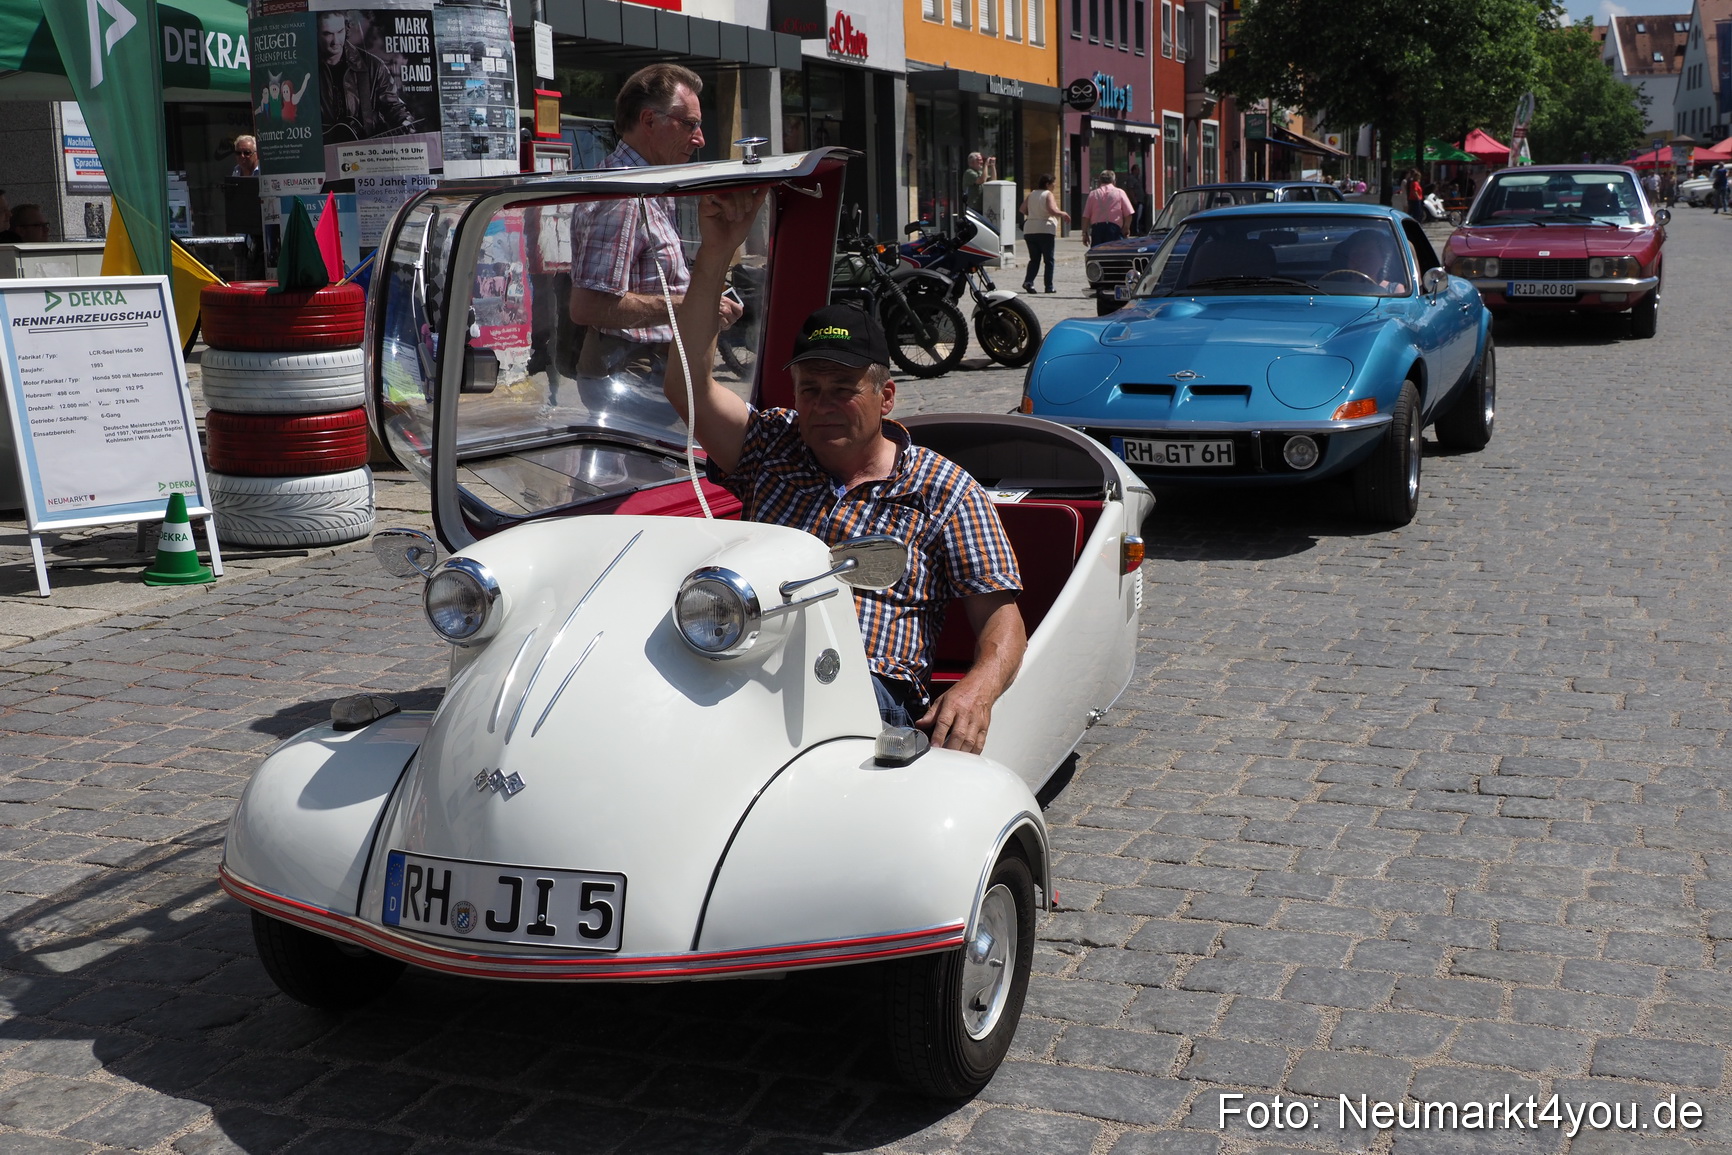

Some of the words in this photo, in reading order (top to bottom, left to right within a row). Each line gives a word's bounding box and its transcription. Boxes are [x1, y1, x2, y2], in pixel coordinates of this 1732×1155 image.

[394, 17, 429, 35] MARK
[164, 25, 251, 70] DEKRA
[385, 36, 430, 54] BENDER
[401, 64, 432, 82] BAND
[416, 84, 433, 92] concert
[256, 129, 284, 142] Sommer
[286, 126, 312, 140] 2018
[283, 178, 316, 187] NEUMARKT
[358, 178, 375, 187] 950
[379, 178, 407, 186] Jahre
[358, 188, 384, 196] Großes
[1542, 284, 1558, 295] RO
[1560, 284, 1574, 295] 80
[68, 290, 127, 307] DEKRA
[12, 310, 162, 326] RENNFAHRZEUGSCHAU
[28, 404, 54, 412] Drehzahl:
[33, 429, 76, 438] Einsatzbereich:
[1124, 441, 1154, 462] RH
[1165, 444, 1194, 464] GT
[1201, 444, 1232, 463] 6H
[169, 480, 196, 490] DEKRA
[48, 494, 88, 506] NEUMARKT
[160, 531, 188, 542] DEKRA
[402, 864, 452, 926] RH
[485, 875, 557, 937] JI
[578, 881, 616, 940] 5
